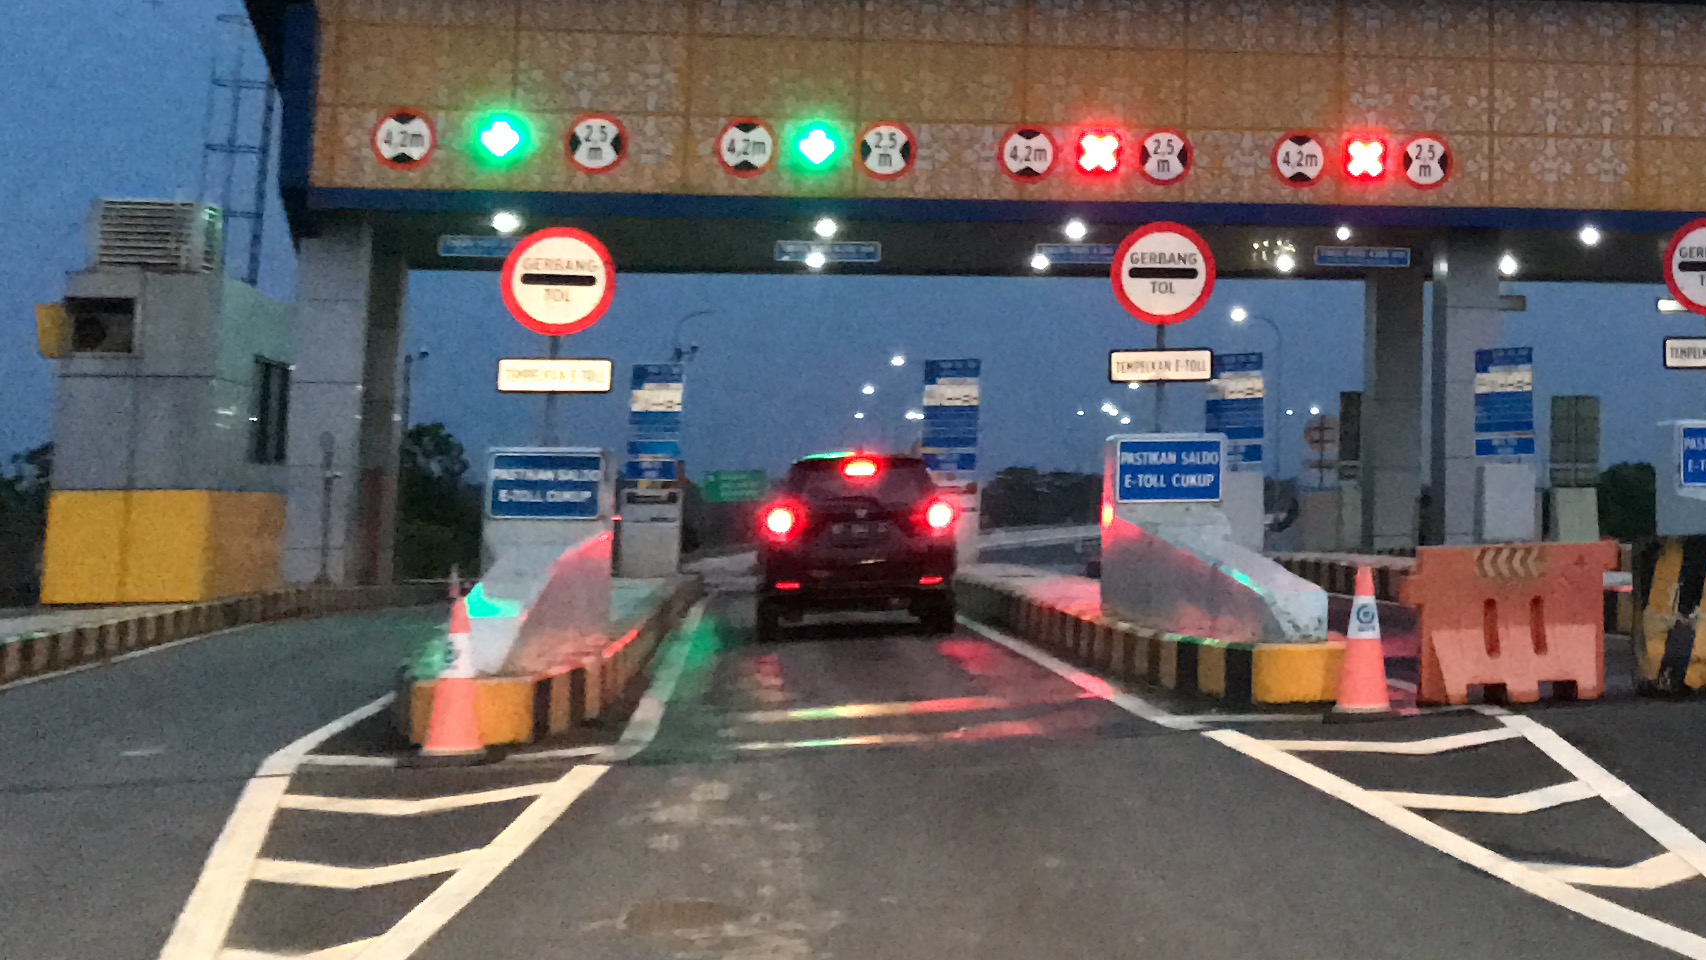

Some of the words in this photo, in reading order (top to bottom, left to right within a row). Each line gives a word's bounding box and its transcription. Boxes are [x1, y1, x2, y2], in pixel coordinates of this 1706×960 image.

[1157, 159, 1170, 172] m
[1419, 164, 1431, 177] m
[522, 258, 598, 272] GERBANG
[1130, 252, 1198, 265] GERBANG
[1151, 281, 1175, 294] TOL
[1121, 451, 1176, 466] PASTIKAN
[1181, 451, 1218, 465] SALDO
[1124, 474, 1166, 488] E-TOLL
[1171, 474, 1215, 488] CUKUP
